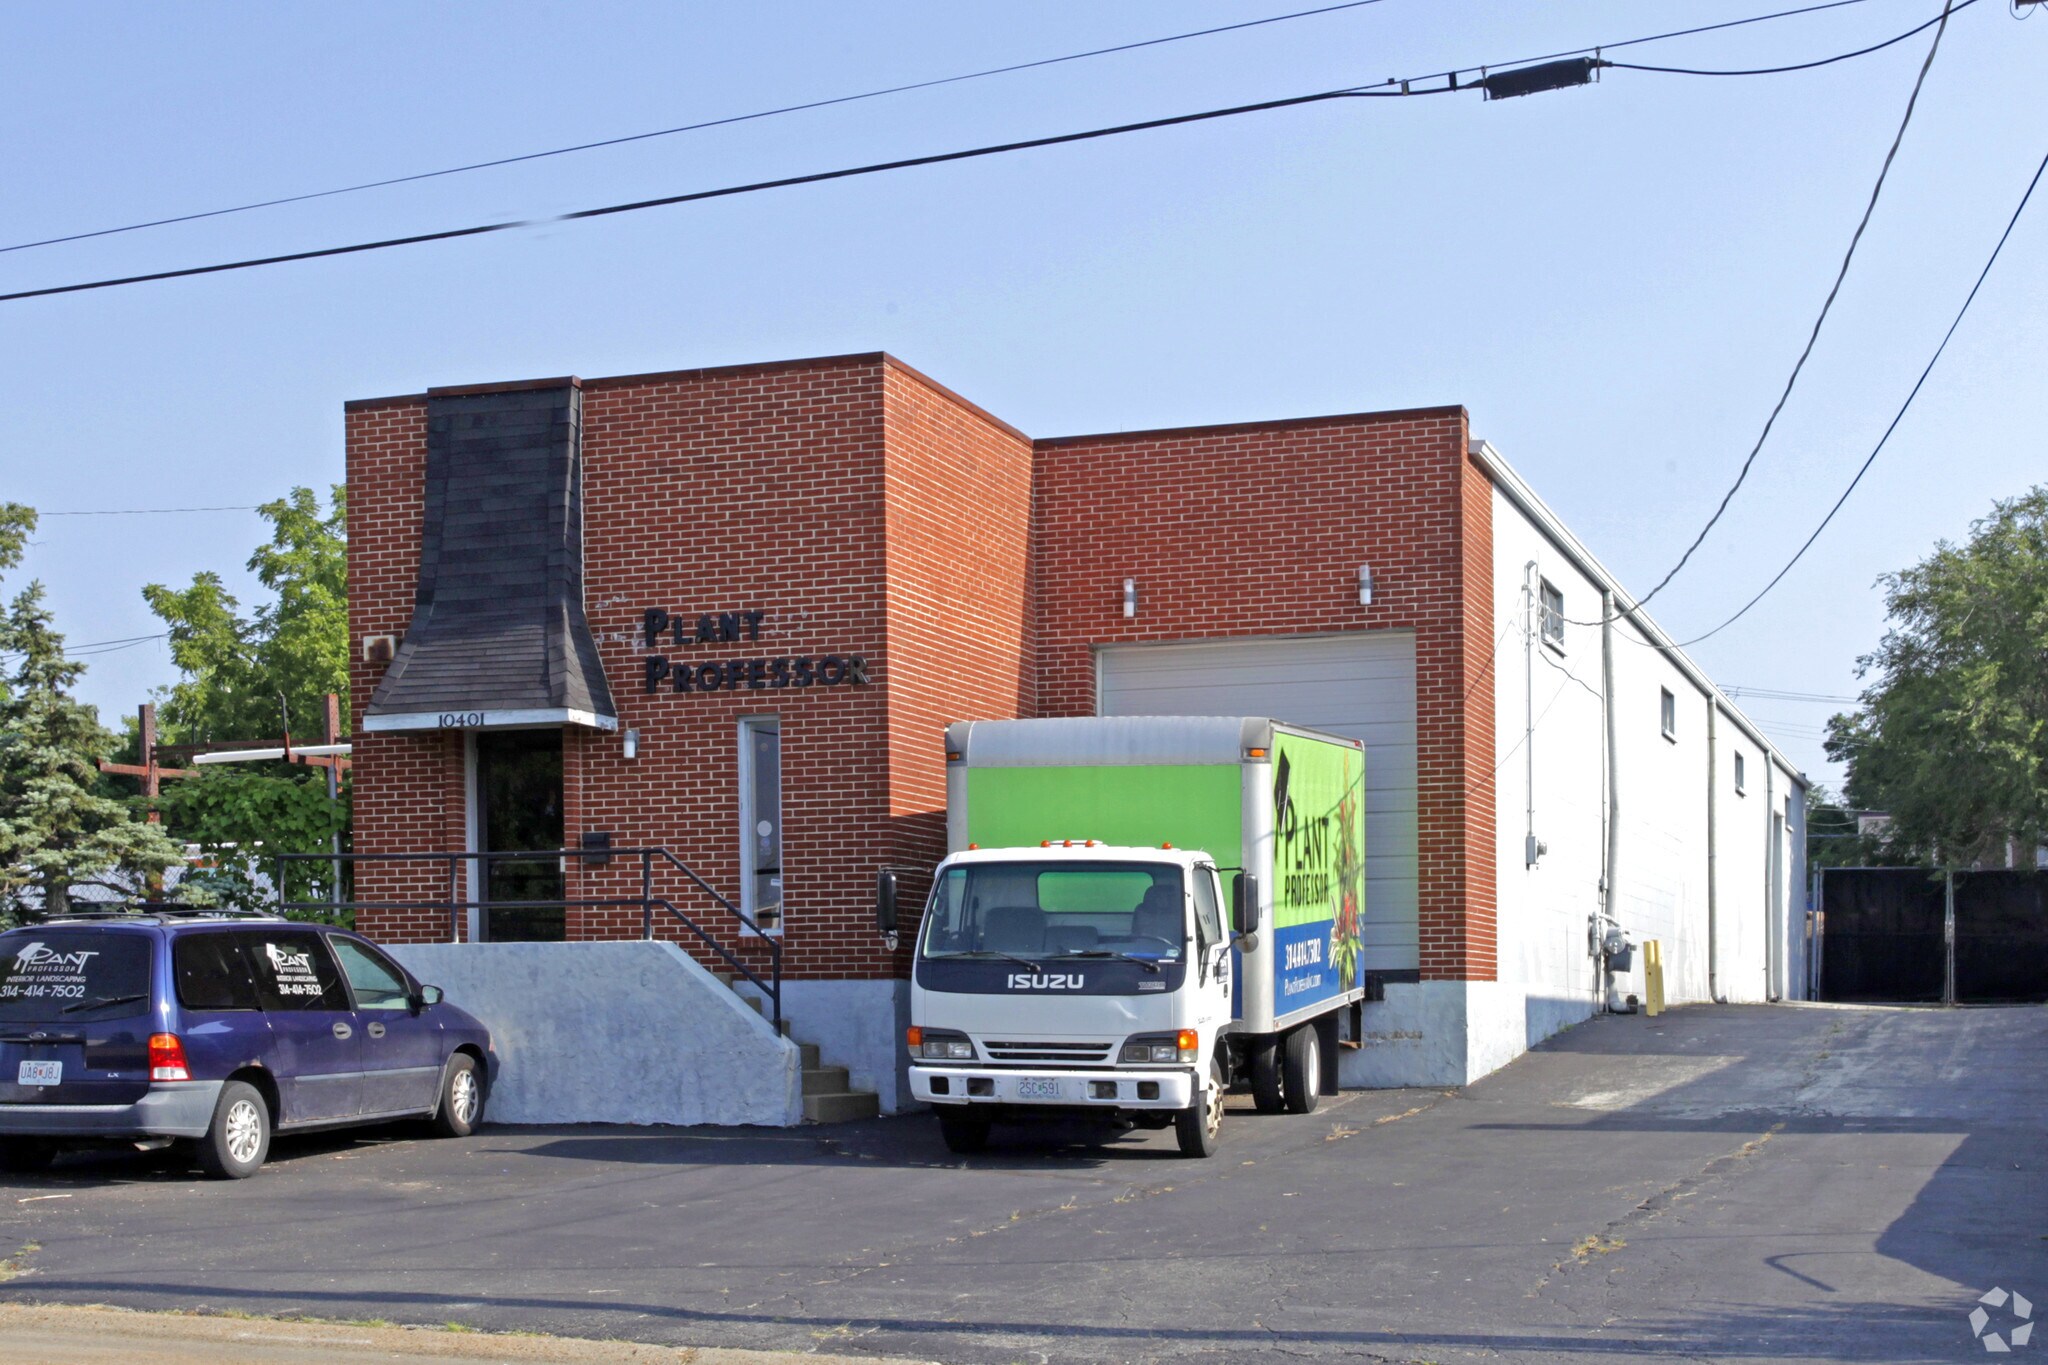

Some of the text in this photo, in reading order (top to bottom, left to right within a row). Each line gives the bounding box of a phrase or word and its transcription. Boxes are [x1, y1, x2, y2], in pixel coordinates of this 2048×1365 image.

[645, 608, 764, 647] PLANT
[645, 655, 871, 694] PROFESSOR
[438, 712, 485, 728] 10401
[1283, 793, 1330, 871] PLANT
[1284, 873, 1329, 908] PROFESSOR
[17, 944, 99, 974] PLANT
[270, 947, 312, 974] PLANT
[36, 975, 87, 983] LANDSCAPING
[278, 984, 323, 995] 314-414-7502
[1007, 974, 1084, 989] ISUZU
[0, 985, 85, 998] 314-414-7502
[1042, 1082, 1060, 1095] 591
